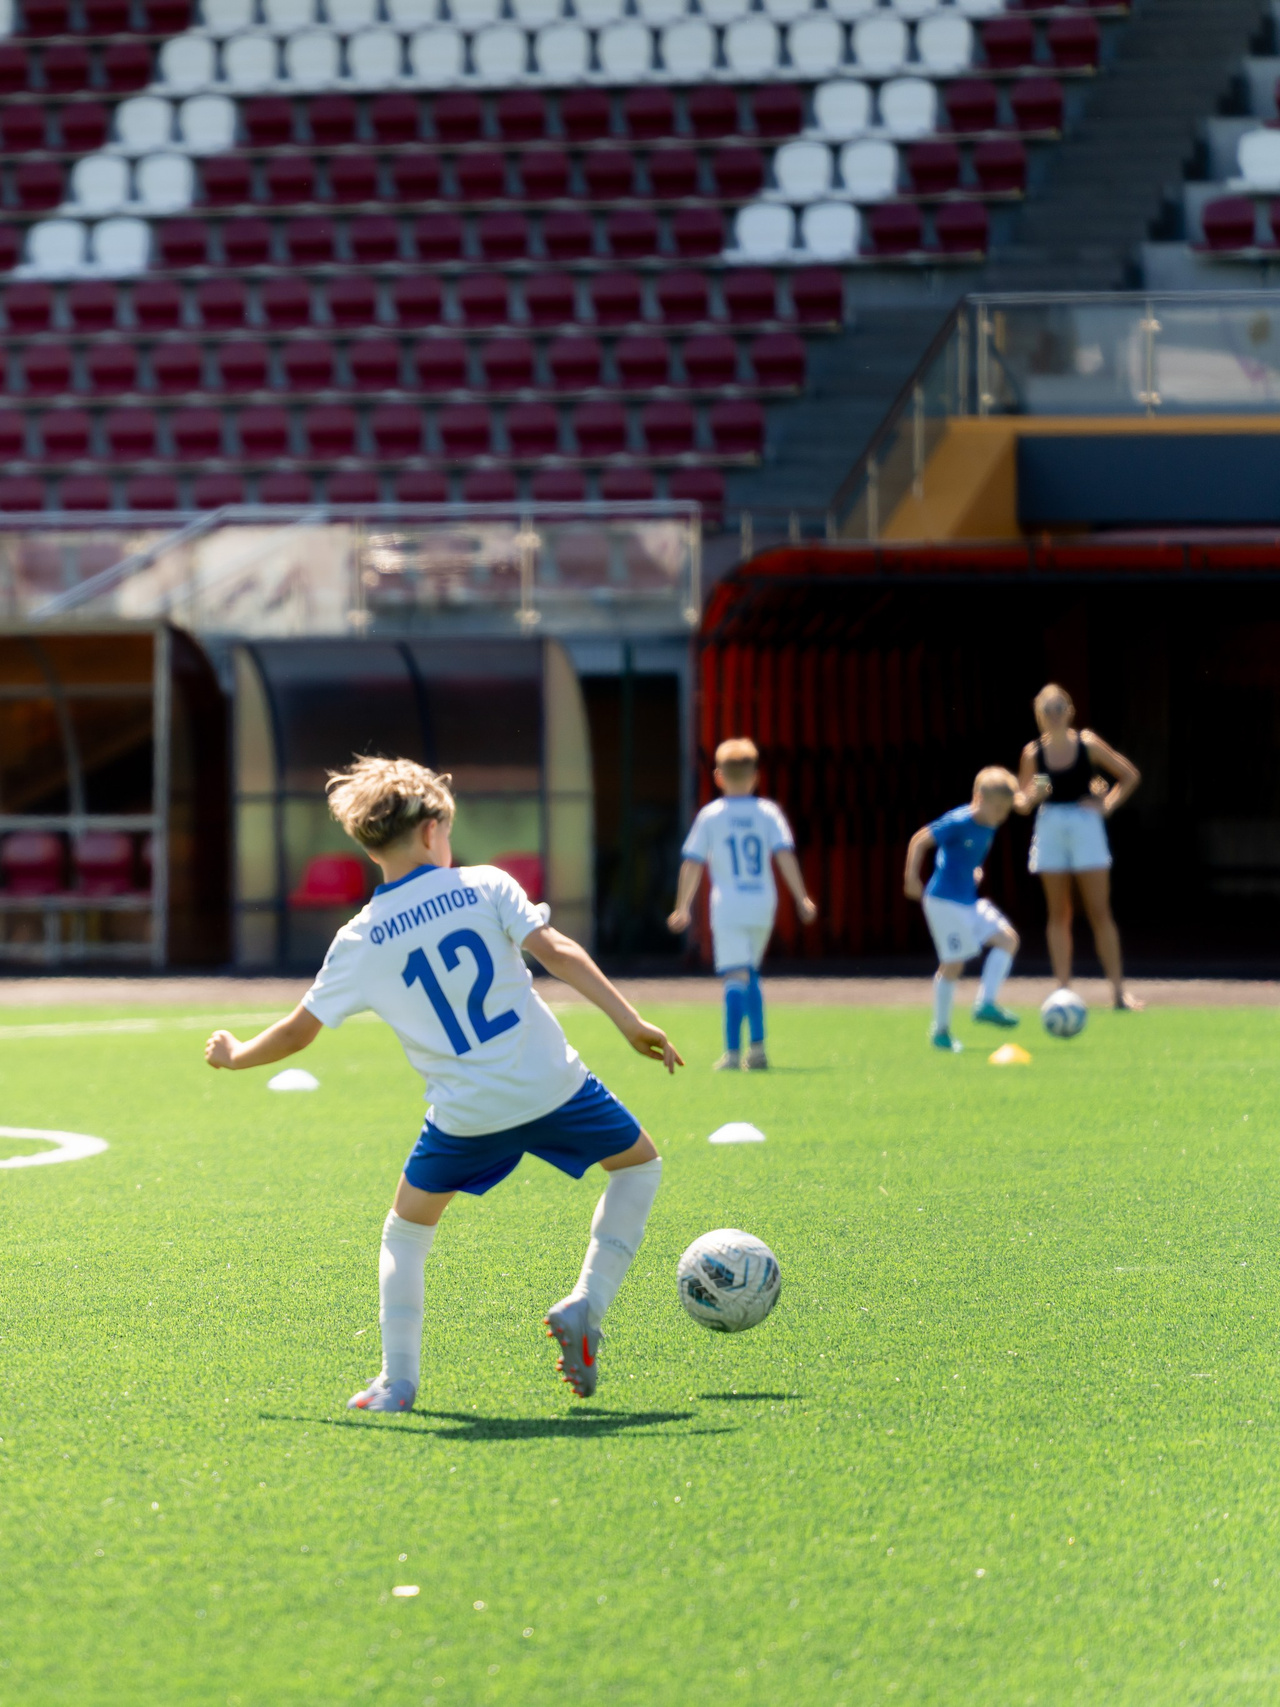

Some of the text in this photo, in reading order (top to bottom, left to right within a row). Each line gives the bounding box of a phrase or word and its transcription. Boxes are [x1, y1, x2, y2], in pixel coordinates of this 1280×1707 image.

[724, 832, 763, 877] 19
[370, 886, 479, 946] ФИЛИППОВ
[400, 927, 521, 1057] 12
